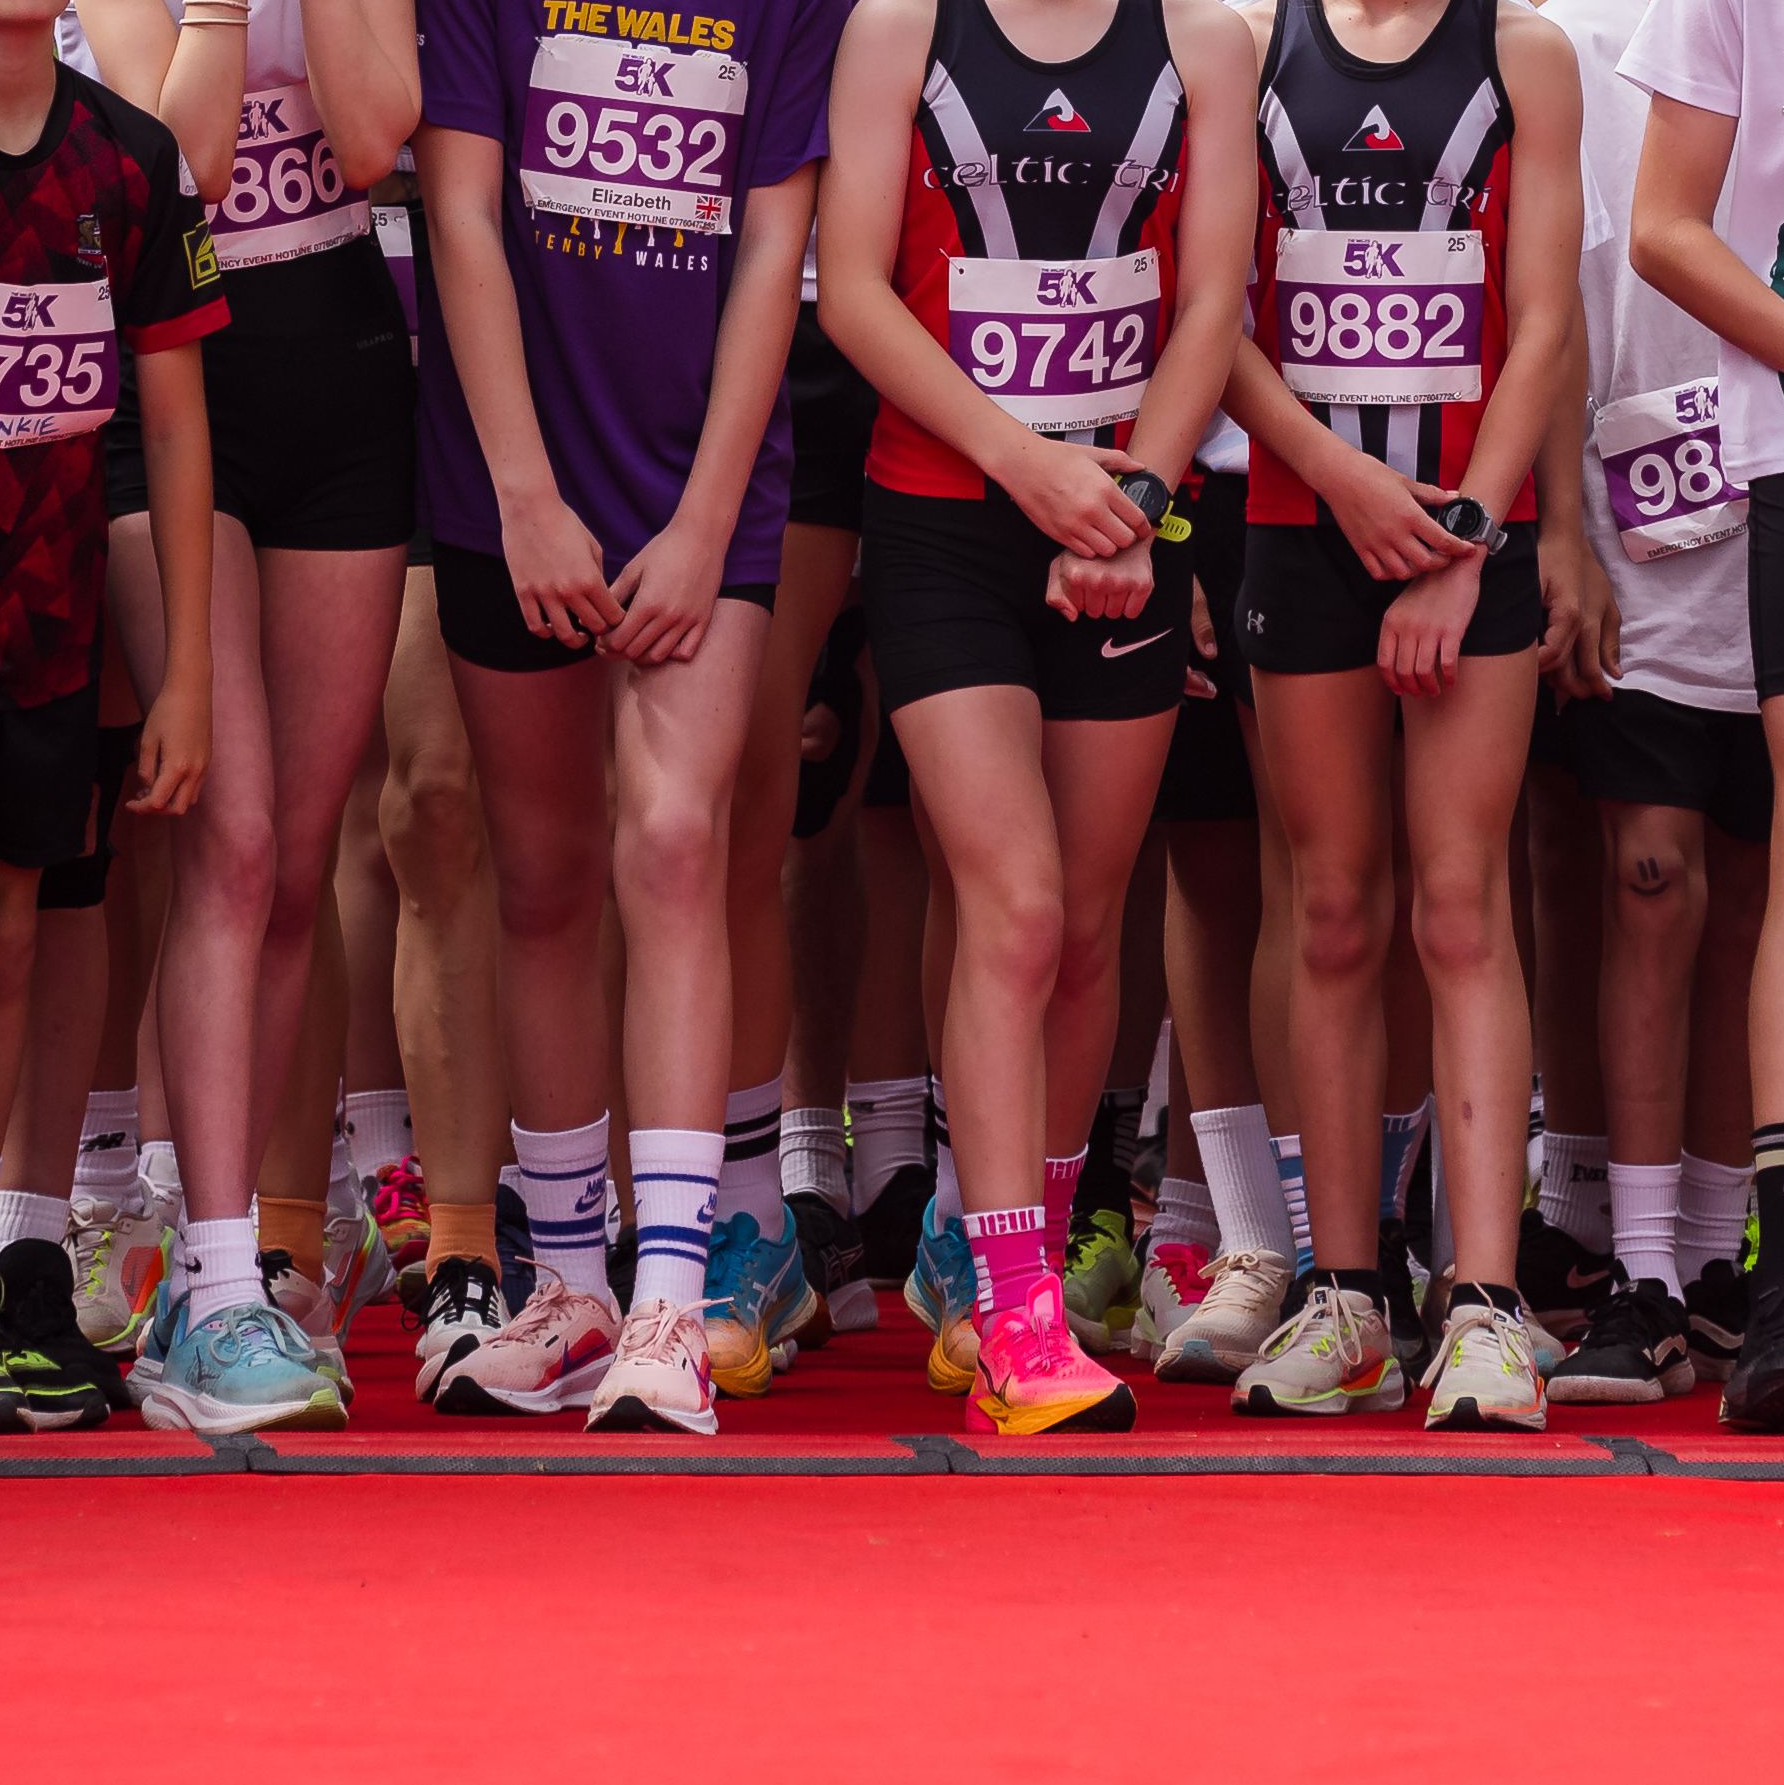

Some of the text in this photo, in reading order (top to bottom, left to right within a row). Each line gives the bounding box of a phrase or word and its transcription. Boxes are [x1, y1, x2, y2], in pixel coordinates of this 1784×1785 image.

[544, 0, 736, 50] THE WALES
[615, 57, 676, 98] 5K
[718, 64, 737, 81] 25
[545, 101, 726, 187] 9532
[205, 138, 345, 224] 866
[592, 187, 672, 211] Elizabeth
[594, 209, 626, 220] EVENT
[626, 212, 668, 225] HOTLINE
[243, 253, 274, 266] EVENT
[275, 246, 312, 261] HOTLINE
[635, 250, 709, 271] WALES
[1343, 241, 1406, 279] 5K
[1447, 237, 1466, 252] 25
[1133, 257, 1148, 273] 25
[1036, 270, 1098, 307] 5K
[1, 293, 58, 332] 5K
[1290, 291, 1465, 360] 9882
[971, 314, 1144, 388] 9742
[1339, 393, 1369, 403] EVENT
[1371, 394, 1411, 404] HOTLINE
[1032, 421, 1062, 431] EVENT
[1065, 417, 1099, 429] HOTLINE
[1629, 439, 1749, 517] 98
[1647, 537, 1702, 559] EMERGENCY
[1704, 528, 1731, 544] EVENT
